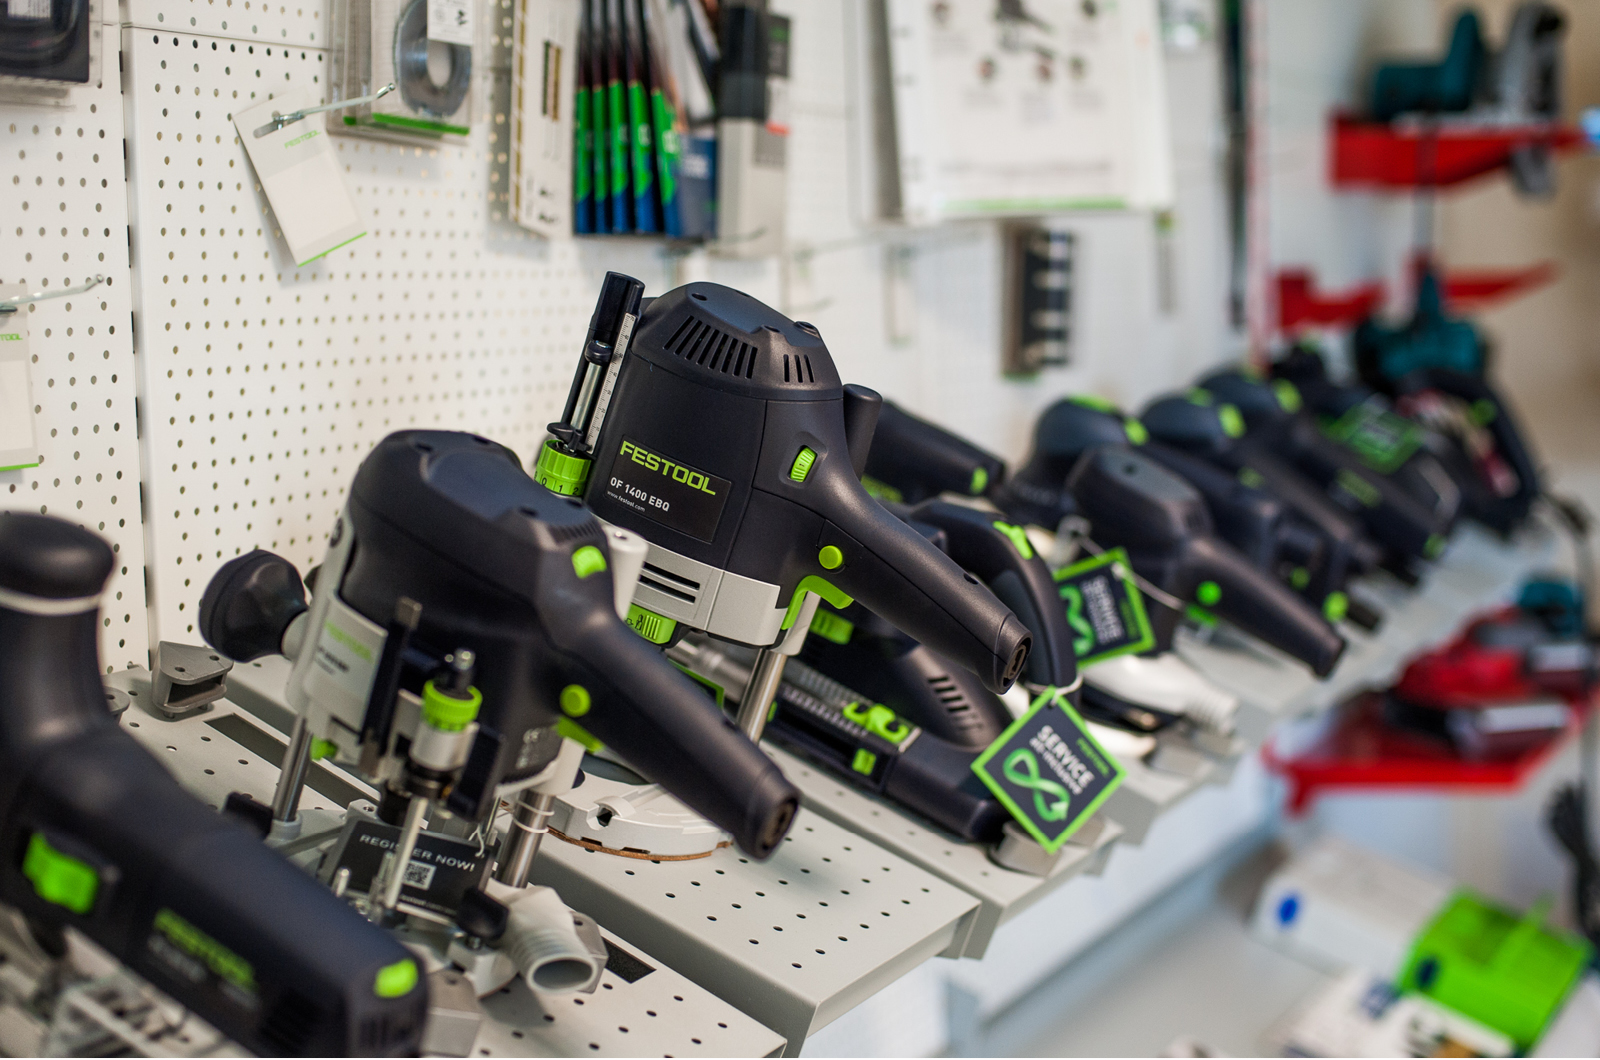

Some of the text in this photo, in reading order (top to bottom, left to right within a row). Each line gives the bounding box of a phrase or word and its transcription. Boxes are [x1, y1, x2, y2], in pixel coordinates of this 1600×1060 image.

[620, 440, 716, 496] FESTOOL
[558, 484, 564, 493] 1
[607, 490, 646, 513] www.festool.com
[610, 477, 670, 512] OF 1400 EBQ
[1037, 725, 1095, 789] SERVICE
[360, 834, 476, 872] REGIER NOW!
